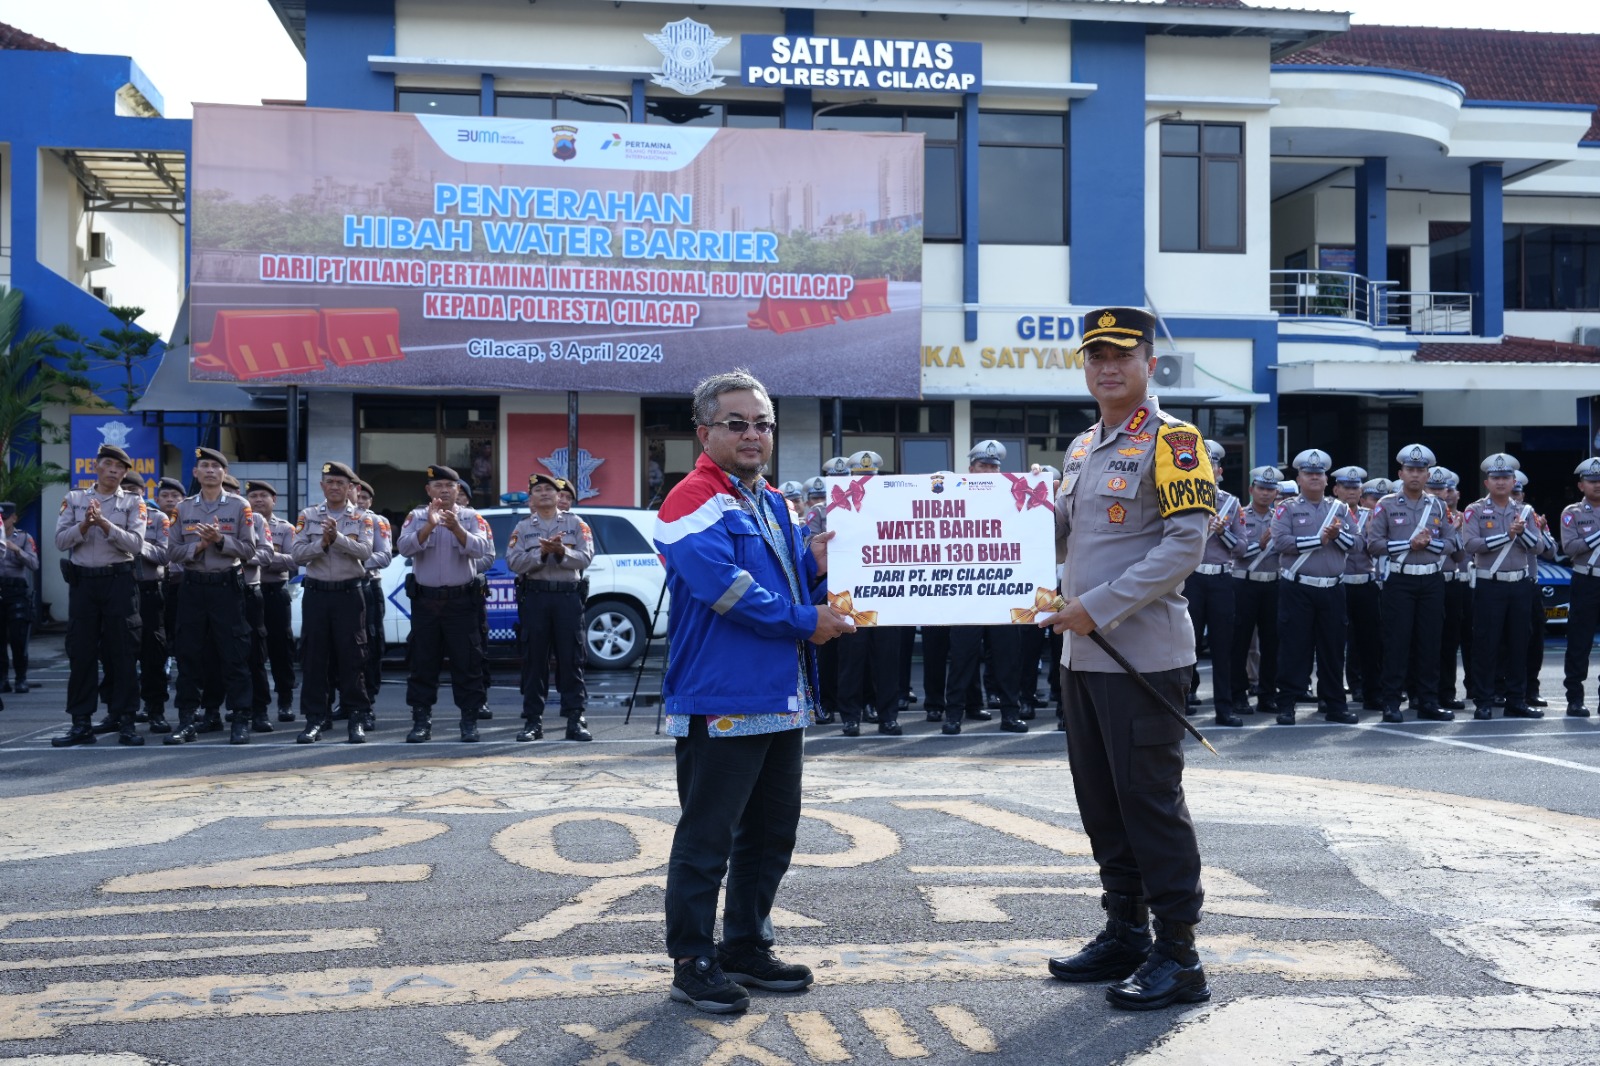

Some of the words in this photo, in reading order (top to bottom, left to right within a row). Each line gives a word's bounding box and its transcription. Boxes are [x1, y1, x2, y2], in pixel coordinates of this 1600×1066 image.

[772, 36, 954, 69] SATLANTAS
[749, 66, 870, 87] POLRESTA
[877, 70, 976, 90] CILACAP
[457, 129, 500, 144] BUMN
[625, 140, 672, 150] PERTAMINA
[434, 183, 693, 225] PENYERAHAN
[344, 215, 472, 252] HIBAH
[484, 220, 613, 257] WATER
[622, 227, 780, 263] BARRIER
[261, 255, 313, 280] DARI
[317, 258, 345, 283] PT
[348, 258, 425, 285] KILANG
[429, 262, 548, 289] PERTAMINA
[550, 266, 706, 295] INTERNASIONAL
[711, 273, 741, 296] RU
[743, 273, 764, 297] IV
[767, 274, 853, 299] CILACAP
[424, 293, 506, 320] KEPADA
[510, 296, 611, 324] POLRESTA
[613, 301, 698, 326] CILACAP
[1017, 315, 1084, 340] GED
[467, 338, 546, 362] Cilacap,
[550, 341, 562, 360] 3
[567, 343, 612, 364] April
[617, 344, 663, 361] 2024
[921, 346, 965, 367] KA
[981, 347, 1084, 369] SATYAW
[1108, 460, 1139, 473] POLRI
[1169, 479, 1195, 508] OPS
[912, 500, 966, 518] HIBAH
[876, 520, 935, 540] WATER
[940, 519, 1002, 538] BARIER
[615, 559, 631, 567] UNIT
[633, 559, 659, 567] KAMSEL
[862, 544, 941, 564] SEJUMLAH
[945, 543, 973, 562] 130
[978, 542, 1021, 561] BUAH
[873, 569, 905, 583] DARI
[908, 569, 927, 582] PT.
[931, 568, 953, 581] KPI
[956, 567, 1013, 580] CILACAP
[853, 585, 905, 598] KEPADA
[909, 583, 973, 597] POLRESTA
[977, 582, 1034, 595] CILACAP
